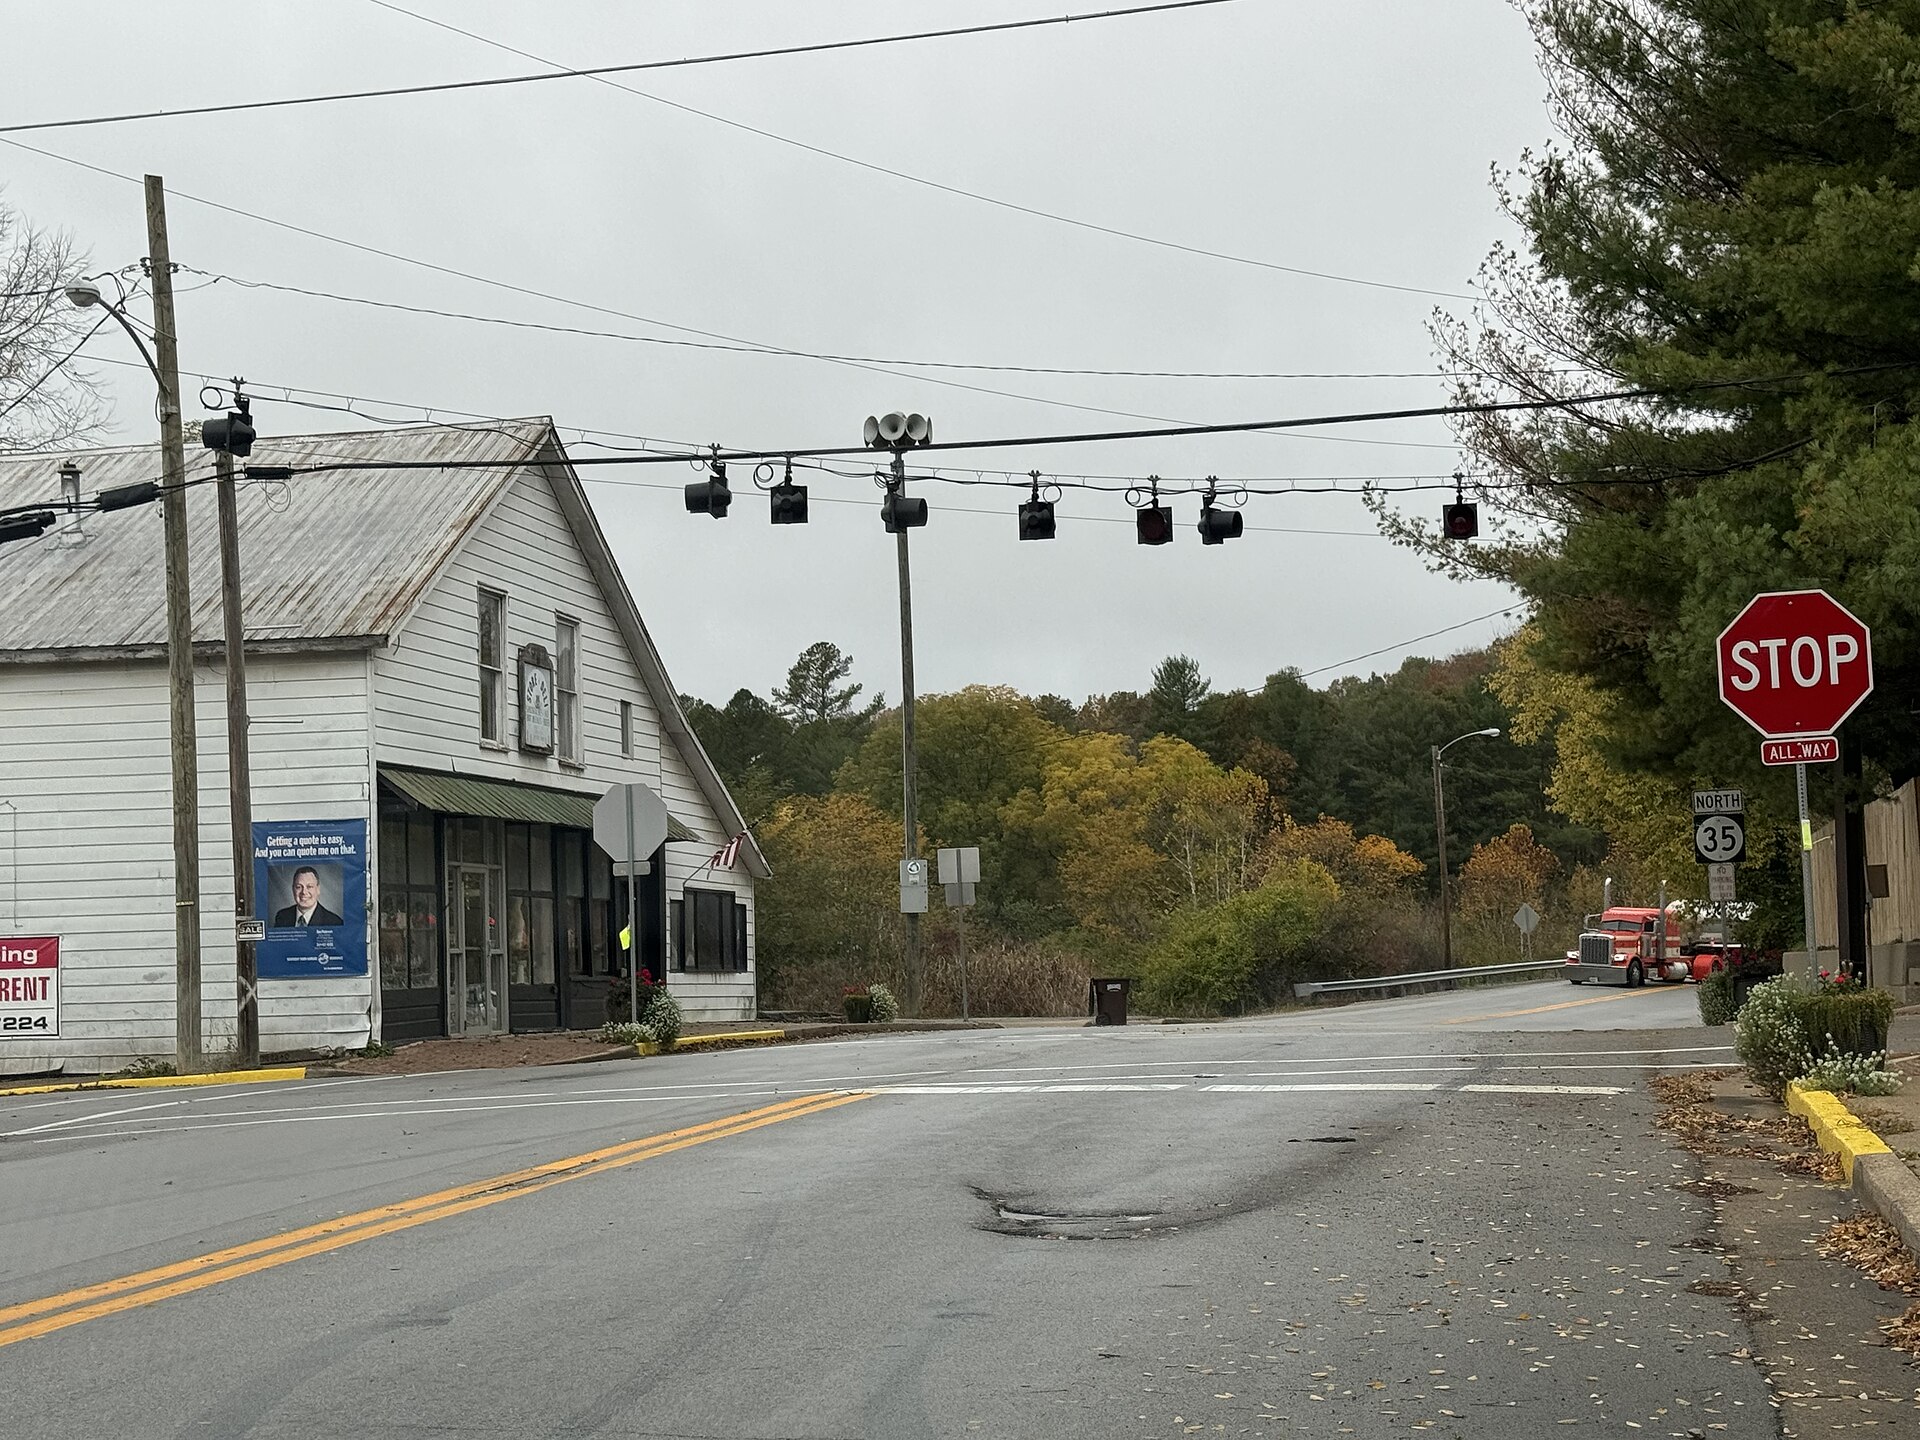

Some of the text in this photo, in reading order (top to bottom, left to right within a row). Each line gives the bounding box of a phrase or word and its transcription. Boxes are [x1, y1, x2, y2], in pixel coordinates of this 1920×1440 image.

[1730, 633, 1859, 692] STOP
[1769, 742, 1830, 760] ALL WAY
[1695, 793, 1740, 809] NORTH
[266, 834, 346, 847] Getting a quote is easy.
[1702, 825, 1737, 853] 35
[254, 844, 357, 860] And you can quote me on that.
[239, 926, 263, 934] SALE
[0, 976, 50, 1001] RENT
[0, 1016, 48, 1030] 224
